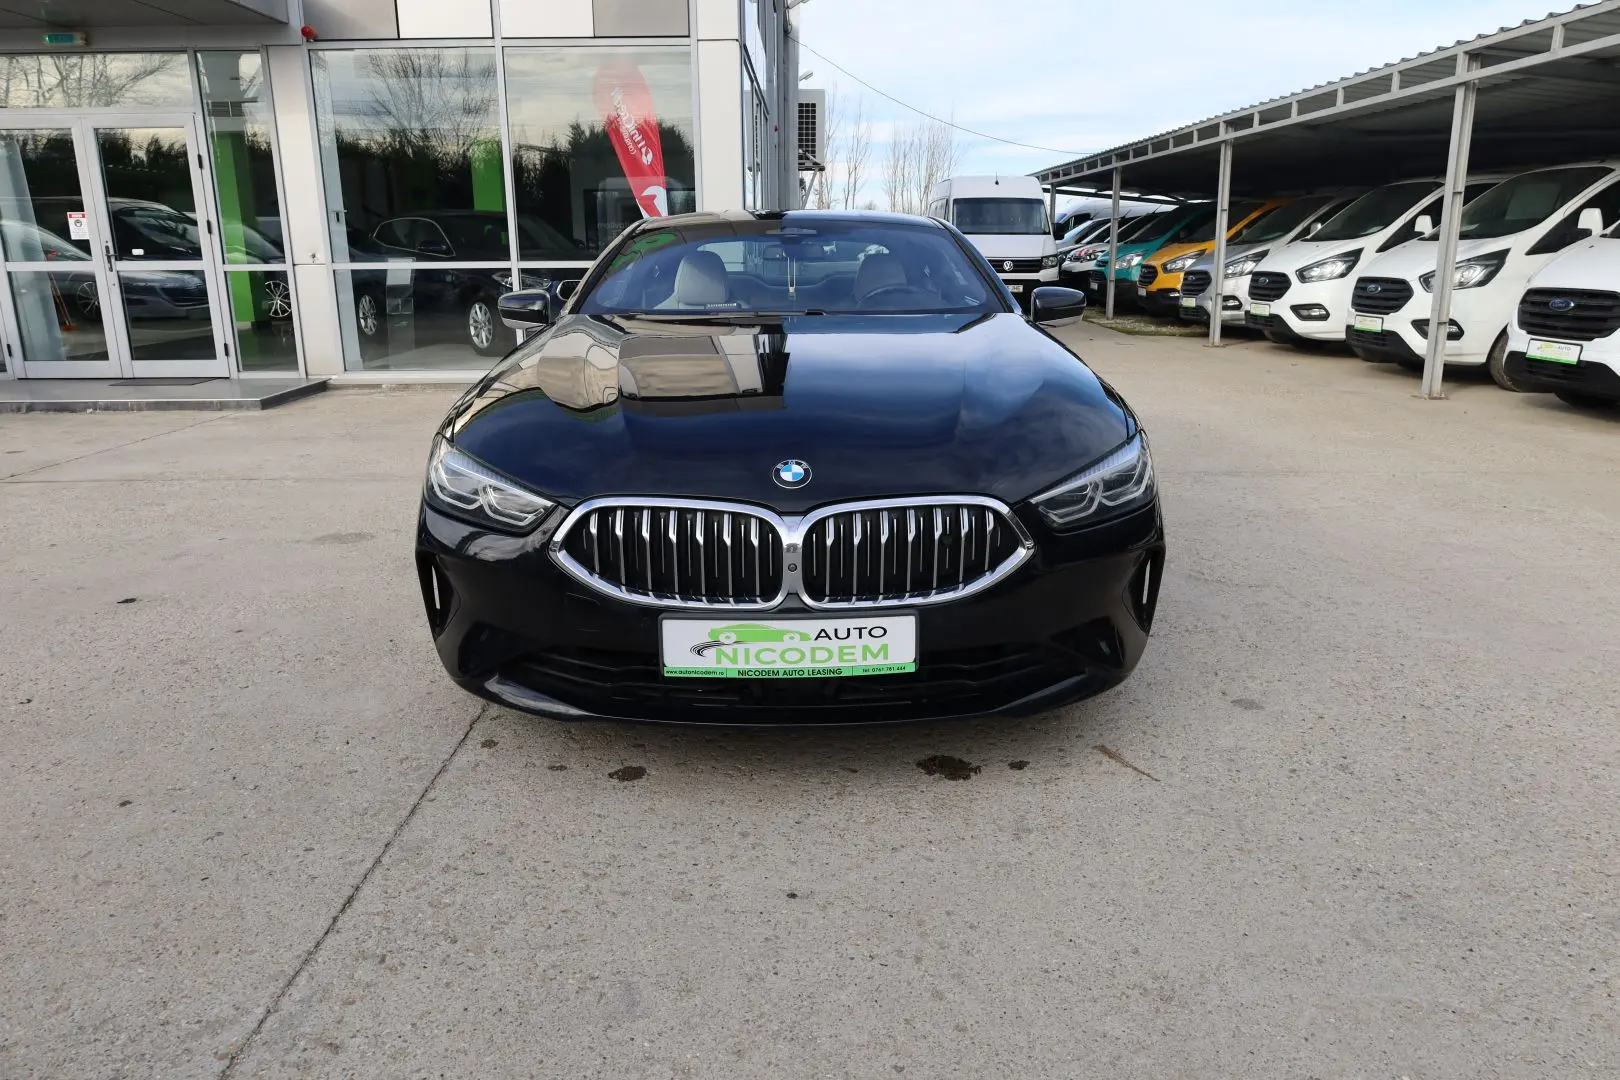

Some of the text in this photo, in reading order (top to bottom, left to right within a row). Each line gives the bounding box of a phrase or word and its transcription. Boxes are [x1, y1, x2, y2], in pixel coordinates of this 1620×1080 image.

[814, 626, 888, 641] AUTO
[716, 643, 889, 665] NICODEM
[737, 667, 843, 677] NICODEM AUTO LEASING
